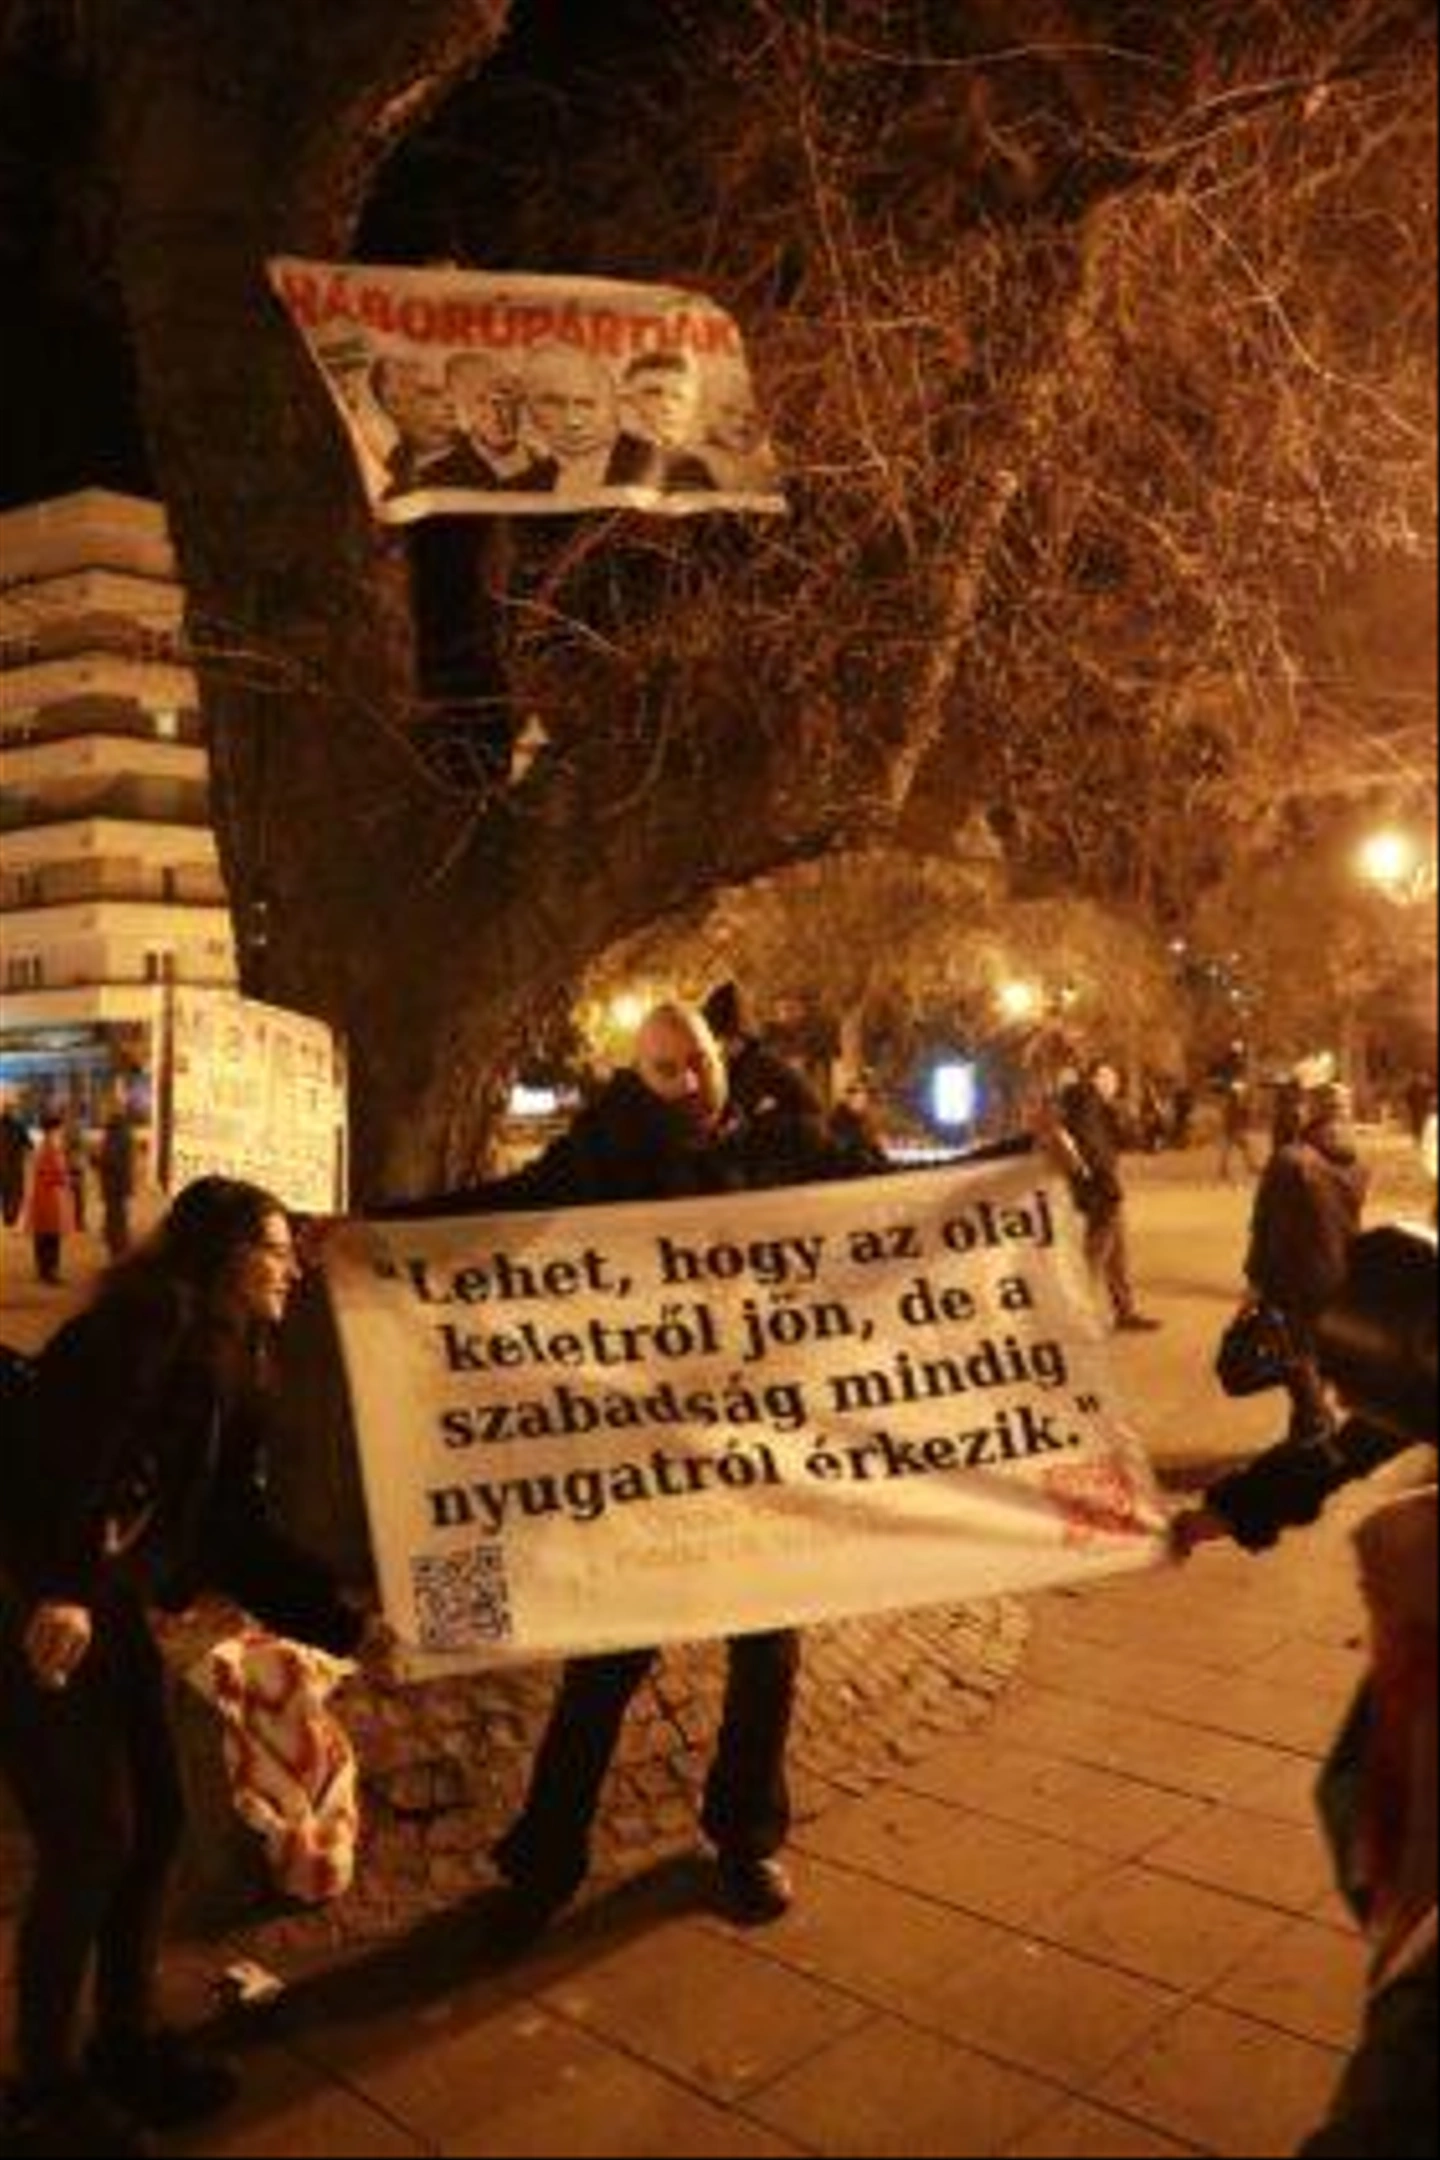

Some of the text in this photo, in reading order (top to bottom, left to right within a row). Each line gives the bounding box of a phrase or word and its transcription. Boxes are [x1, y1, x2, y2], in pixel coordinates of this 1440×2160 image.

[656, 1234, 824, 1284] hogy
[849, 1224, 923, 1264] az
[943, 1190, 1054, 1253] olaj
[436, 1275, 1033, 1373] keletről jön, de a
[440, 1335, 1067, 1449] szabadság mindig
[427, 1438, 784, 1537] nyugatról
